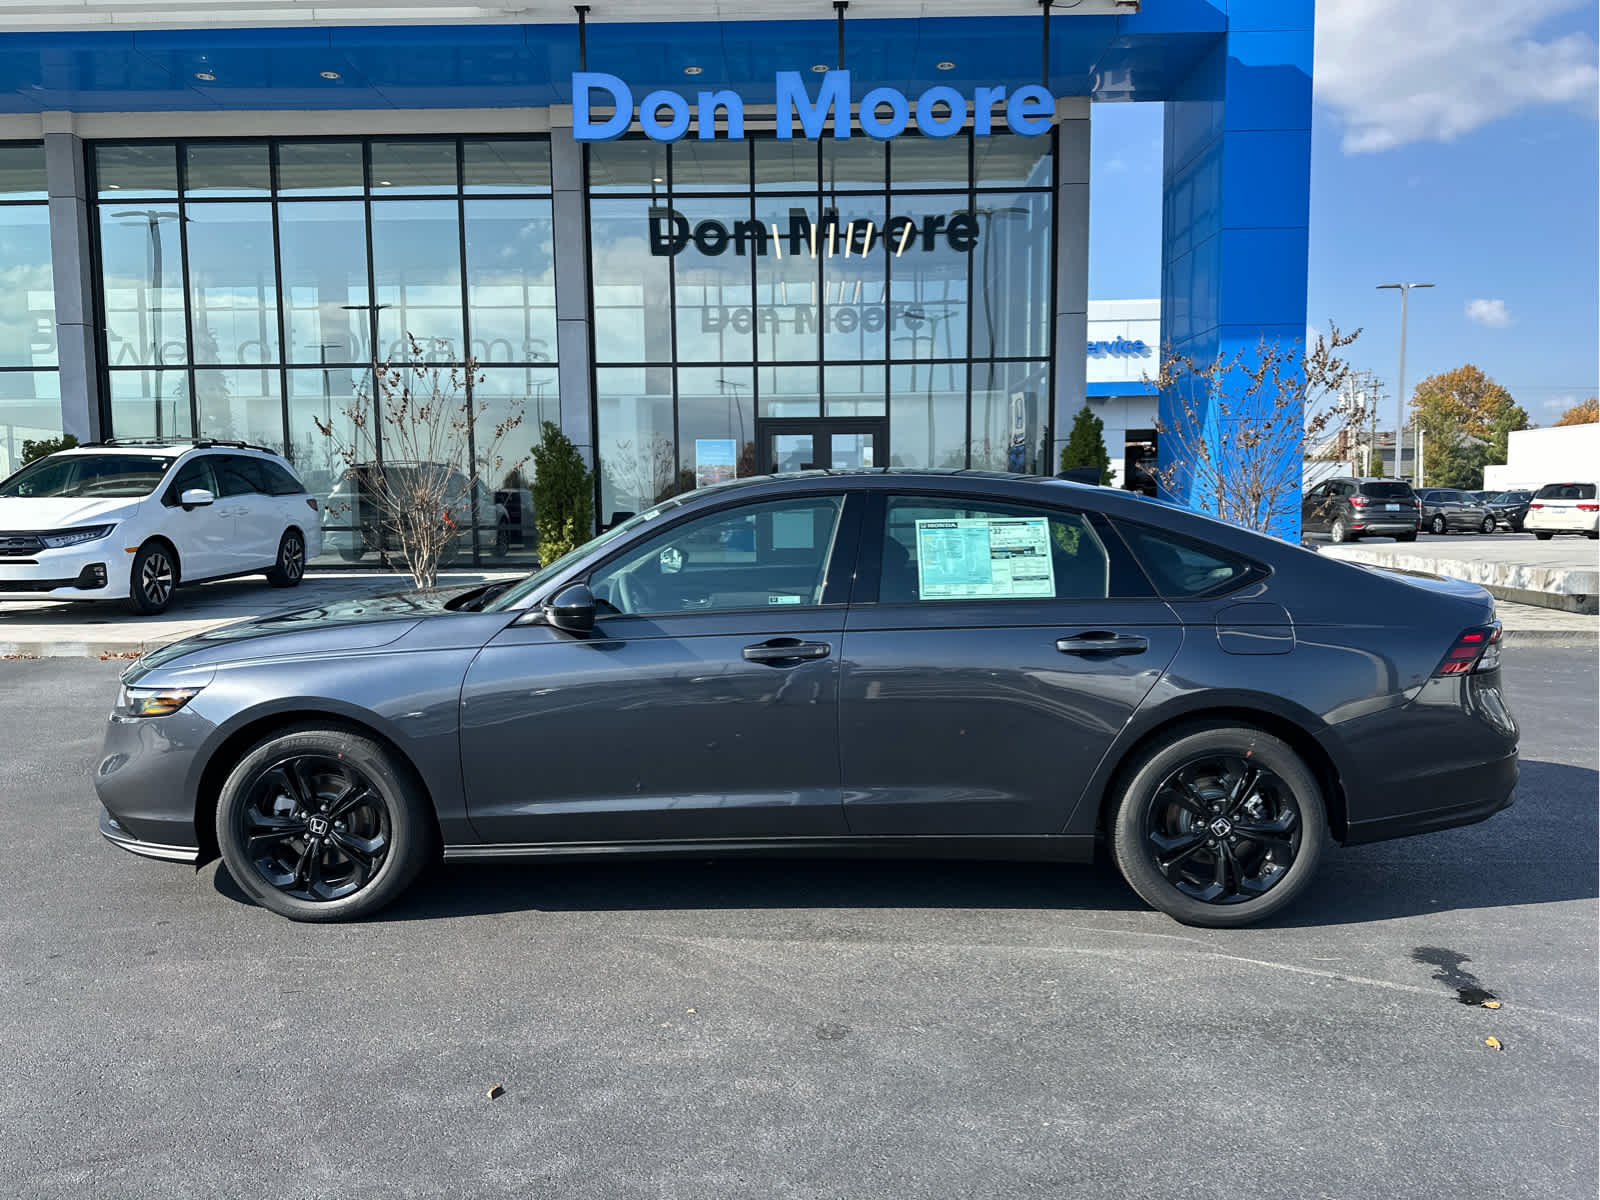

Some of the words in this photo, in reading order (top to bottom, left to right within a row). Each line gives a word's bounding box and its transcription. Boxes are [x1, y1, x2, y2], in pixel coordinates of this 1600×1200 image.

[571, 72, 745, 143] Don
[775, 69, 1056, 141] Moore
[648, 206, 768, 257] Don
[789, 206, 980, 257] Moore
[701, 304, 780, 334] Don
[793, 303, 926, 334] Moore
[1087, 335, 1146, 354] ervice
